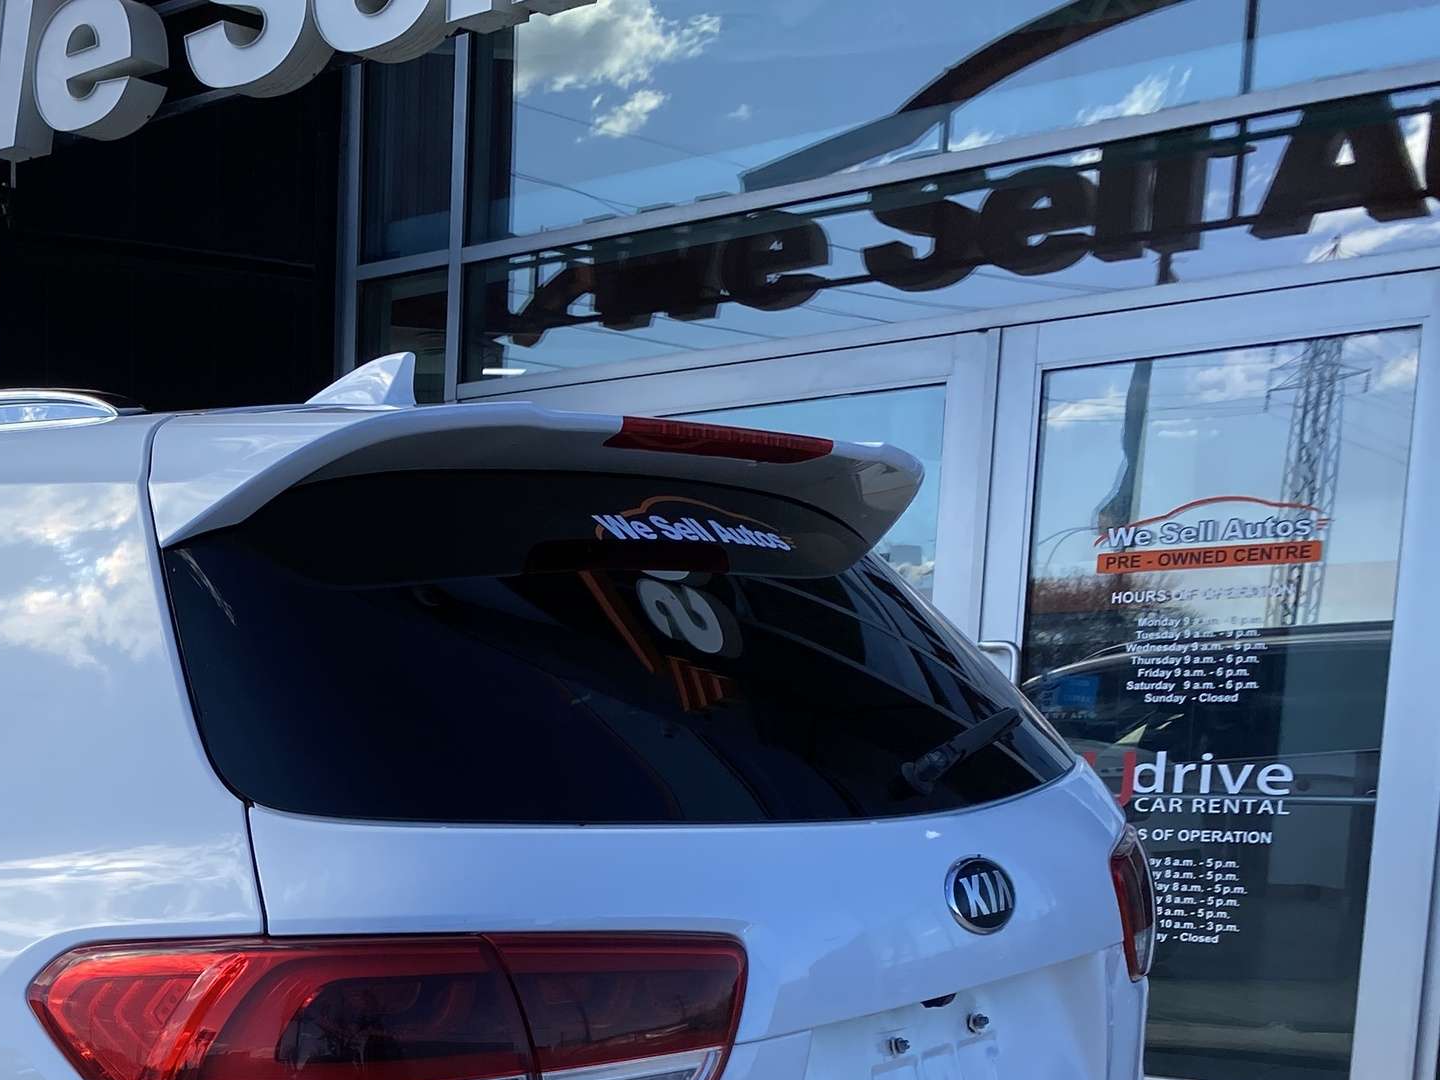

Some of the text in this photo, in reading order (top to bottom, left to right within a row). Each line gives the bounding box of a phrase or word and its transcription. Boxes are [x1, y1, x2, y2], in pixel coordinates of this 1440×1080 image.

[591, 514, 792, 551] We Sell Autos
[1107, 516, 1312, 548] We Sell Autos
[1105, 555, 1141, 569] PRE
[1158, 550, 1227, 567] OWNED
[1233, 544, 1313, 562] CENTRE
[1112, 590, 1167, 604] HOURS
[1137, 617, 1181, 627] Monday
[1135, 631, 1181, 641] Tuesday
[1184, 630, 1190, 639] 9
[1235, 629, 1261, 640] p.m.
[1125, 643, 1189, 653] Wednesday
[1191, 642, 1198, 651] 9
[1200, 643, 1224, 652] a.m.
[1243, 642, 1268, 652] p.m.
[1130, 656, 1182, 666] Thursday
[1183, 655, 1191, 664] 9
[1226, 655, 1233, 664] 6
[1235, 656, 1260, 666] p.m.
[1137, 669, 1172, 679] Friday
[1174, 668, 1181, 677] 9
[1216, 667, 1223, 676] 6
[1225, 668, 1250, 678] p.m.
[1126, 681, 1176, 692] Saturday
[1183, 681, 1190, 690] 9
[1193, 682, 1216, 690] a.m.
[1225, 681, 1233, 689] 6
[1235, 681, 1260, 691] p.m.
[1144, 693, 1186, 704] Sunday
[1198, 693, 1239, 703] Closed
[1134, 797, 1291, 815] CAR RENTAL
[1152, 829, 1174, 841] OF
[1177, 830, 1273, 844] OPERATION
[1164, 857, 1171, 866] 8
[1172, 858, 1197, 867] a.m.
[1206, 858, 1213, 867] 5
[1214, 860, 1240, 870] p.m.
[1164, 870, 1171, 879] 8
[1172, 871, 1197, 880] a.m.
[1206, 871, 1213, 880] 5
[1214, 873, 1240, 882] p.m.
[1172, 882, 1180, 891] 8
[1180, 884, 1205, 893] a.m.
[1214, 884, 1221, 893] 5
[1222, 886, 1248, 895] p.m.
[1165, 894, 1172, 904] 8
[1173, 896, 1197, 905] a.m.
[1207, 896, 1214, 905] 5
[1215, 898, 1240, 908] p.m.
[1164, 908, 1188, 917] a.m.
[1197, 909, 1205, 918] 5
[1206, 911, 1231, 920] p.m.
[1160, 919, 1172, 929] 10
[1173, 921, 1197, 930] a.m.
[1206, 922, 1214, 930] 3
[1215, 924, 1240, 933] p.m.
[1179, 932, 1220, 944] Closed
